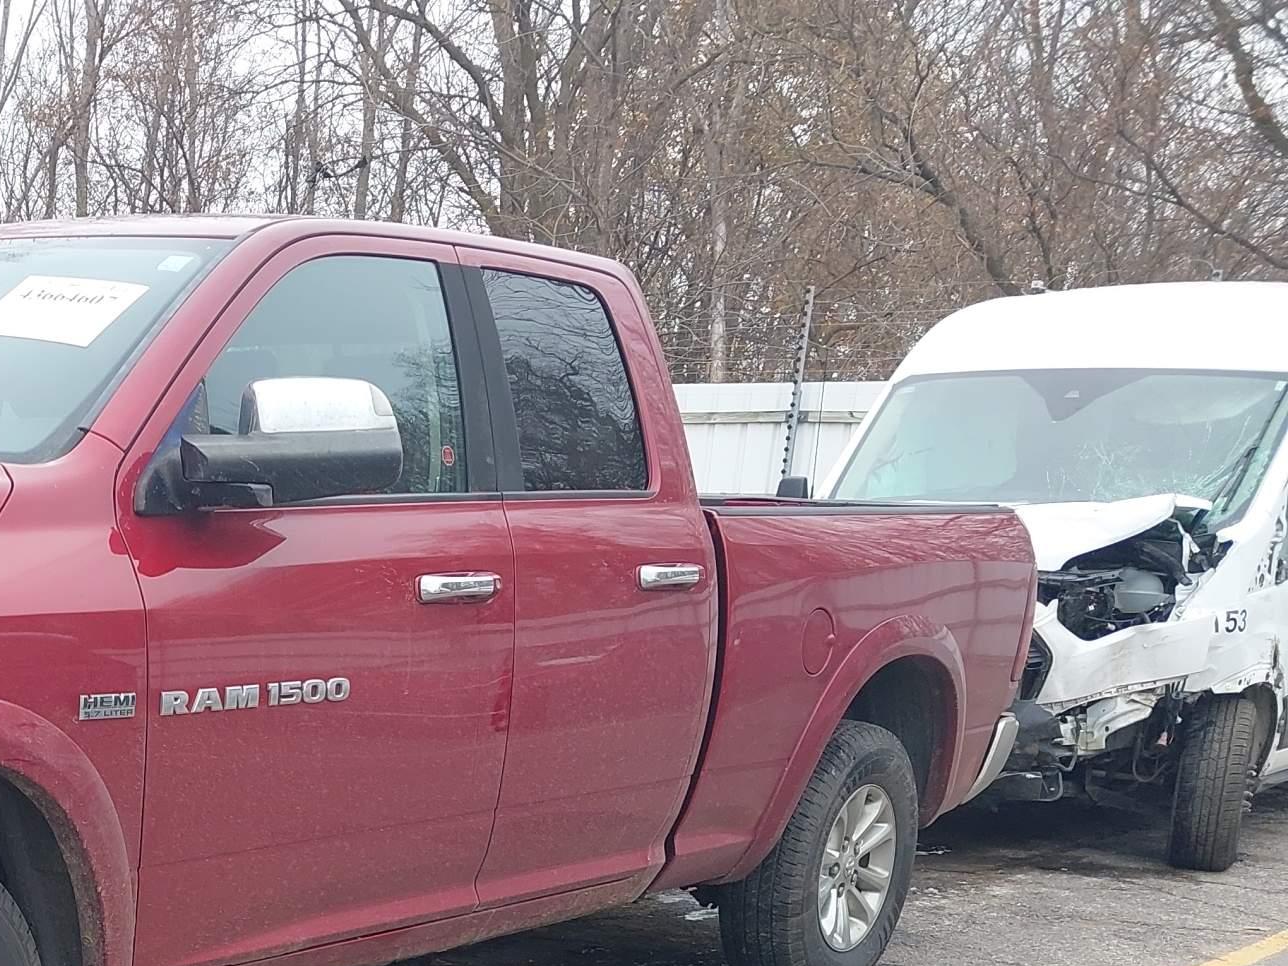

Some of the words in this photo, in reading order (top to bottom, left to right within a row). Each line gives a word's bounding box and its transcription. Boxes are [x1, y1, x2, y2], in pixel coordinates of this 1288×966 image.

[82, 694, 136, 710] HEMI
[160, 684, 260, 716] RAM
[267, 677, 351, 707] 1500
[103, 708, 134, 717] LITER
